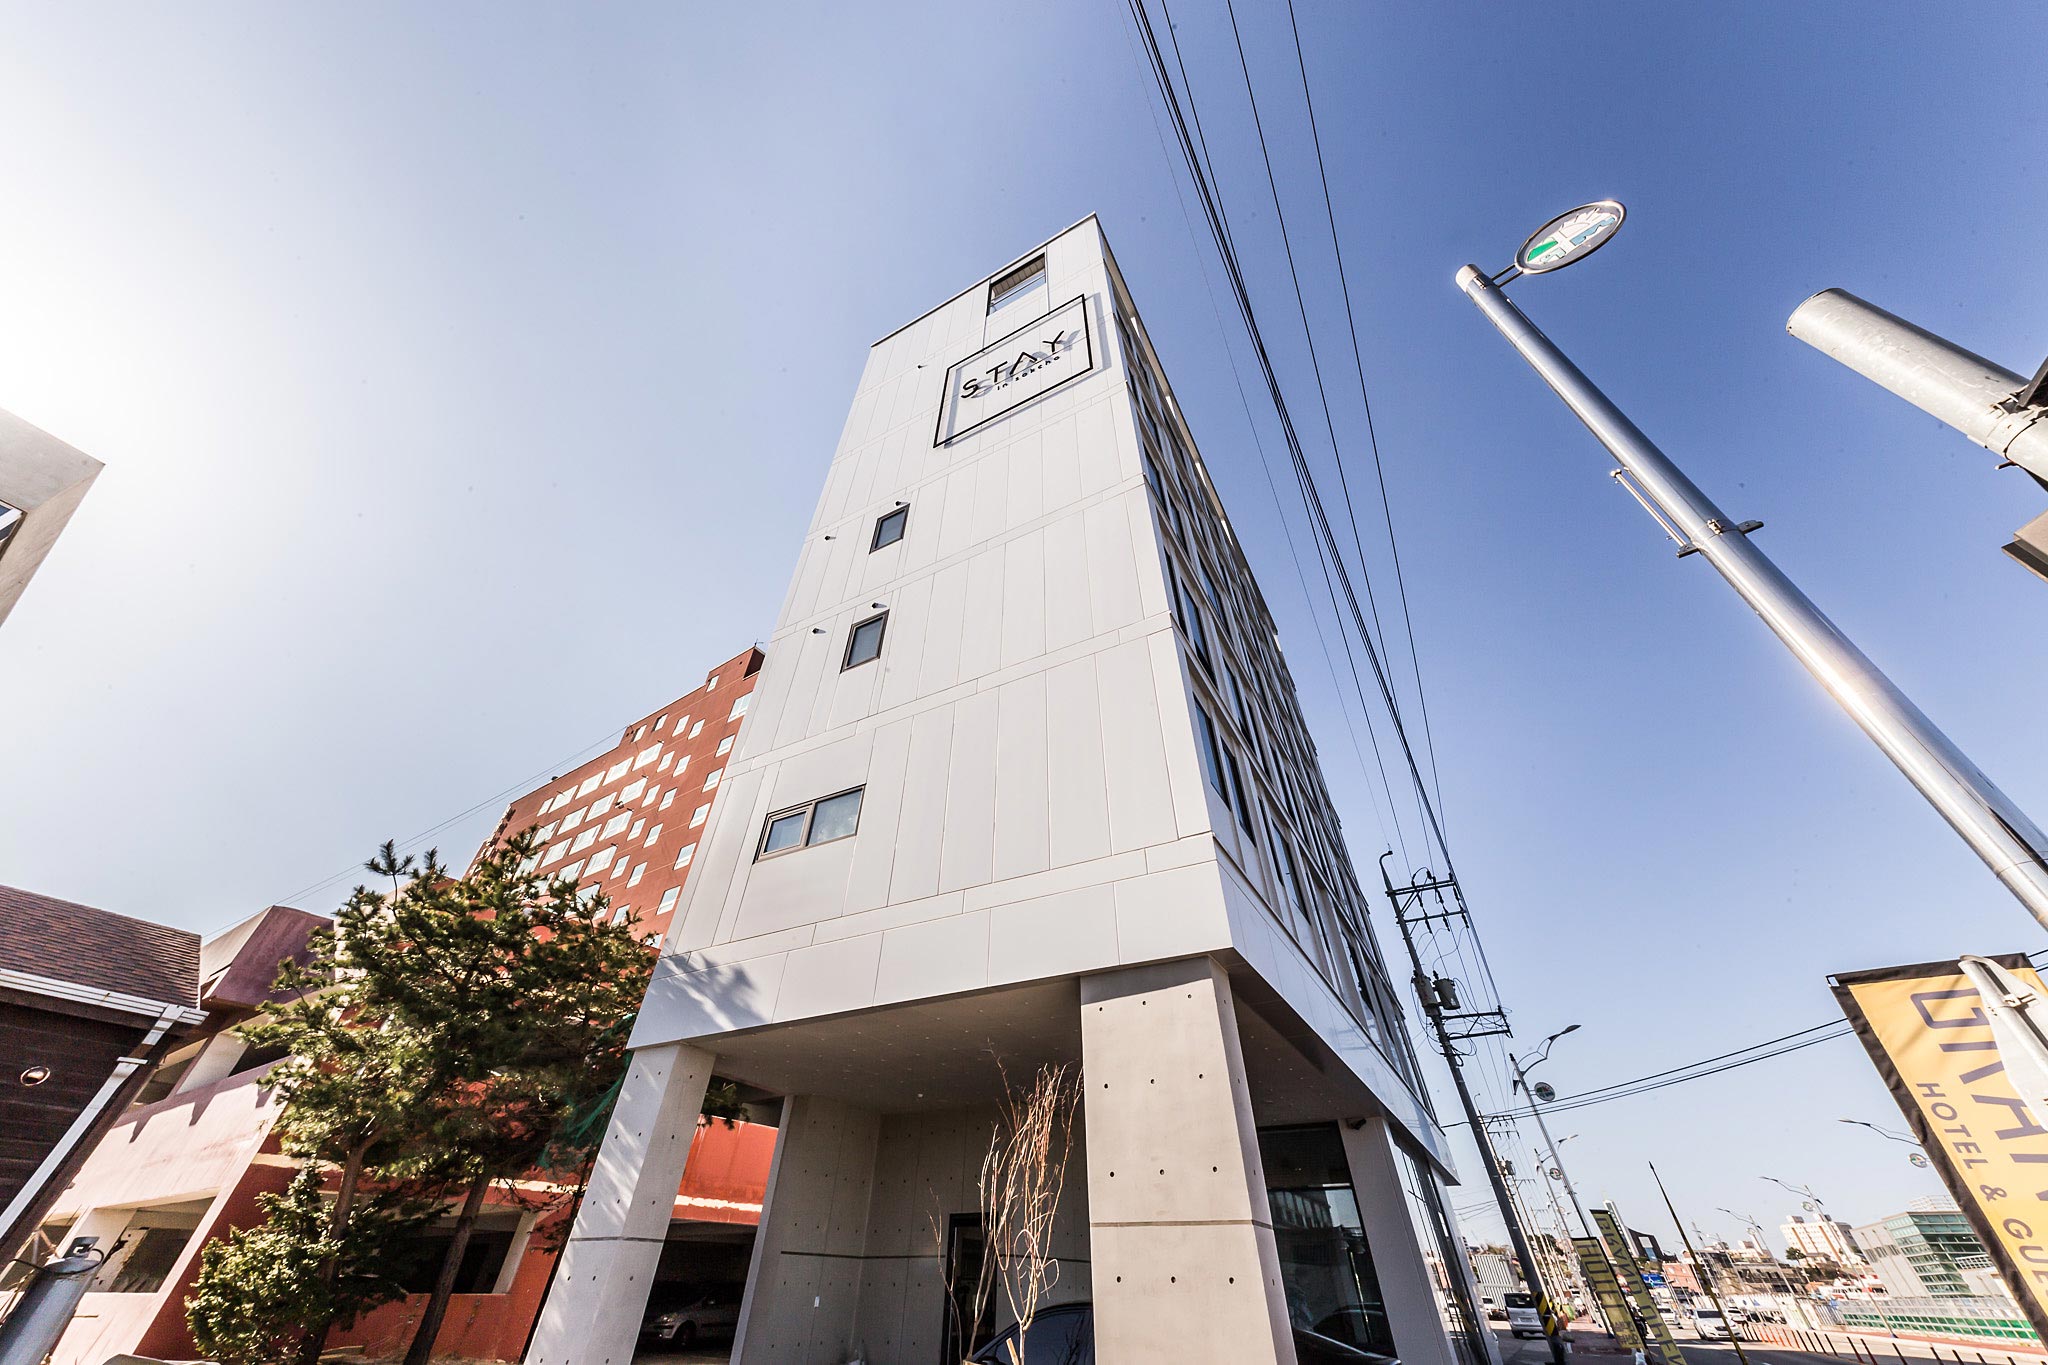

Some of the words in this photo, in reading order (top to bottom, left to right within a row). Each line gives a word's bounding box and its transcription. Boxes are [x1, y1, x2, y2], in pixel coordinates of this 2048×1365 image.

[961, 330, 1064, 398] STAY
[997, 382, 1008, 391] in
[1916, 1083, 1988, 1169] HOTEL
[1980, 1184, 2008, 1202] &
[2002, 1218, 2048, 1298] GUE
